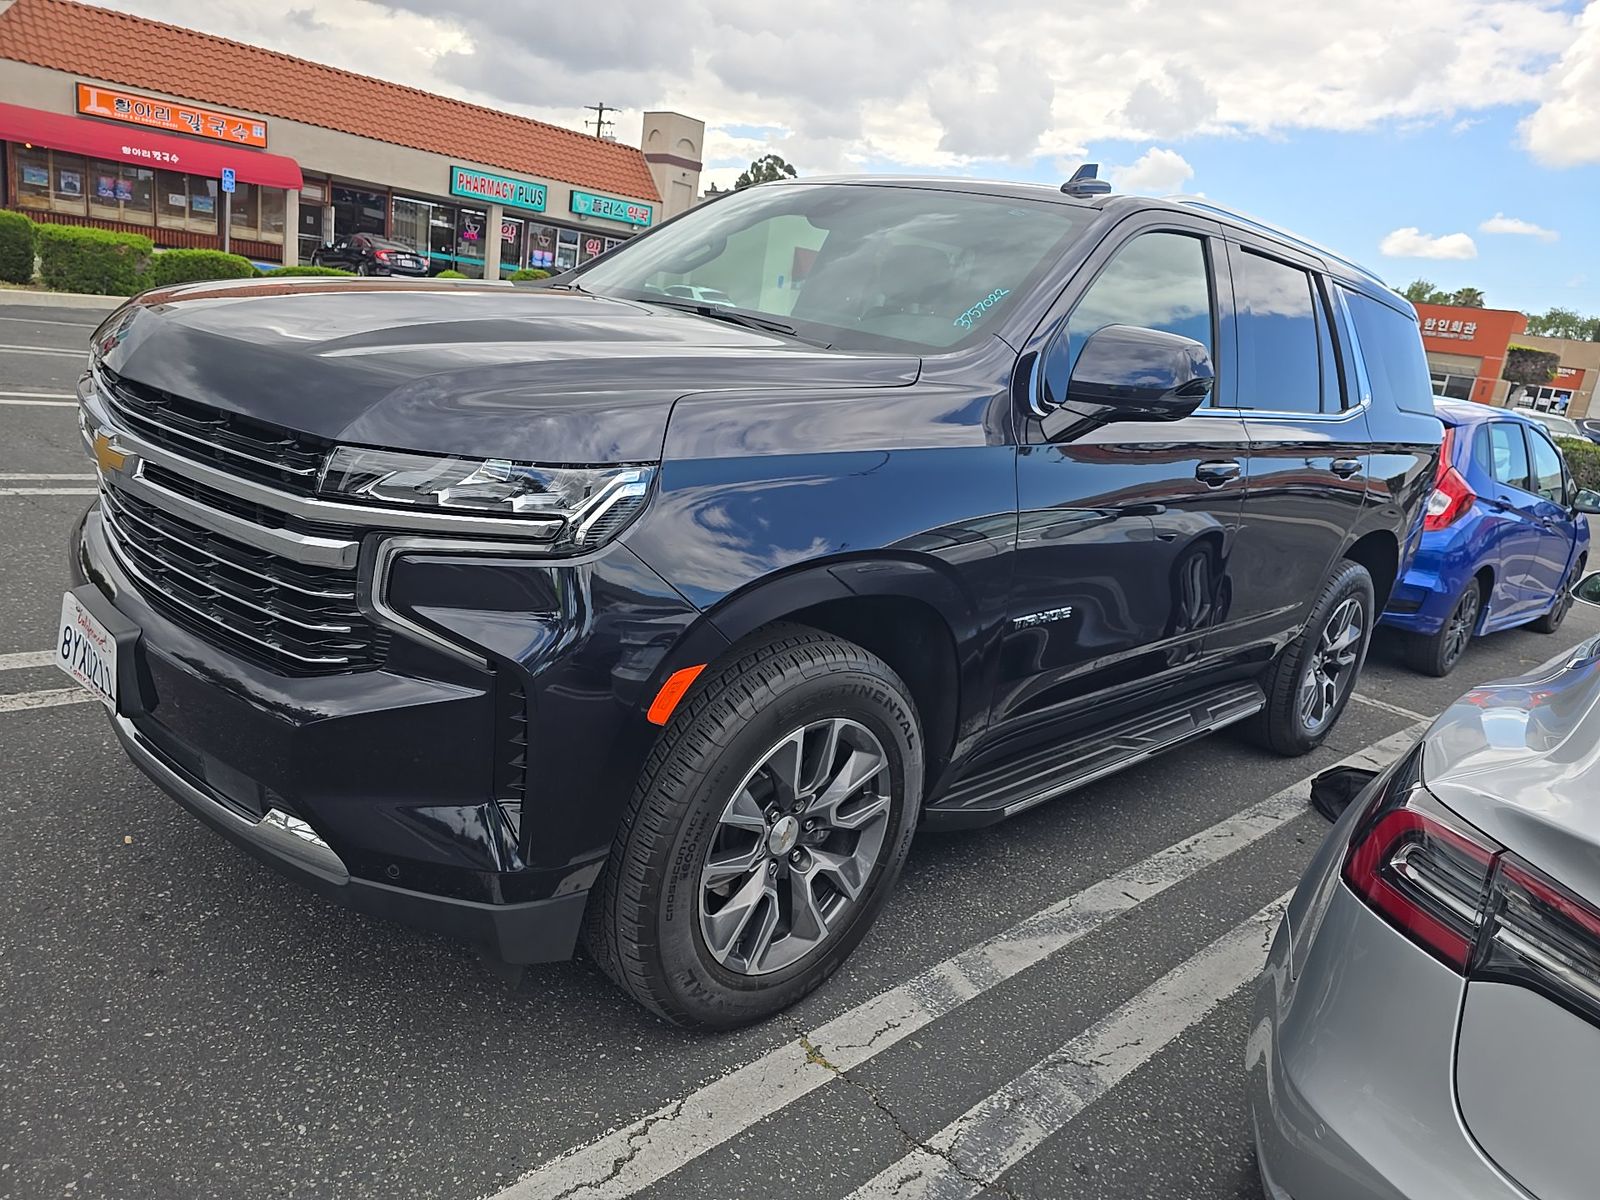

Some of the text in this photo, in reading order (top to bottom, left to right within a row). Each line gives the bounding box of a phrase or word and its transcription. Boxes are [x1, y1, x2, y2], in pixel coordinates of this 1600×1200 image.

[179, 111, 248, 141] 칼국수
[457, 172, 544, 207] PHARMACY PLUS
[592, 198, 650, 222] 플러스 약국
[501, 222, 517, 243] 약
[586, 238, 601, 258] 약
[953, 288, 1010, 330] 3757022
[1423, 317, 1477, 335] 한인회관
[1012, 606, 1073, 631] TAHOE
[61, 625, 116, 702] 8YXD211
